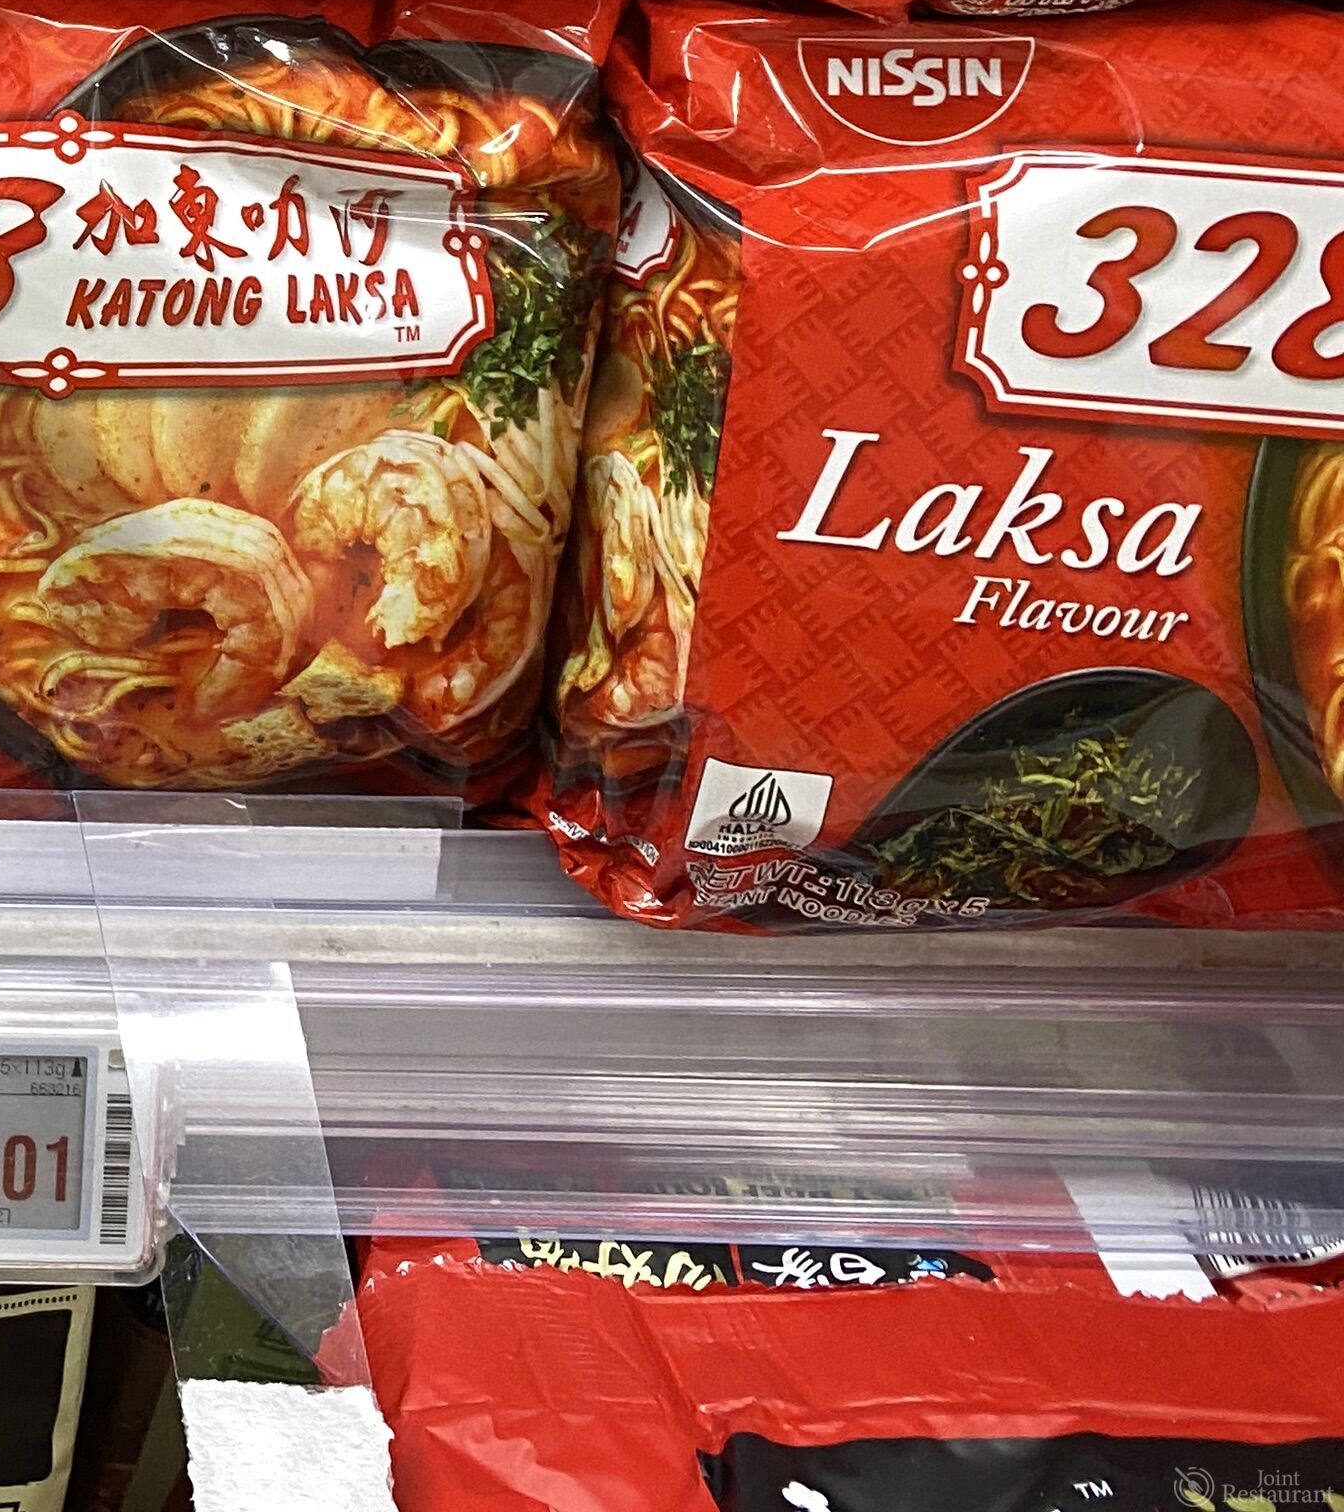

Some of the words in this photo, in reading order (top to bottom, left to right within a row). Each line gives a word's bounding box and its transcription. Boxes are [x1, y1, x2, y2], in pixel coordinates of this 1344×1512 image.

[827, 49, 1002, 107] NISSIN
[66, 275, 263, 330] KATONG
[286, 268, 420, 325] LAKSA
[394, 325, 421, 343] TM
[777, 428, 1202, 576] Laksa
[953, 575, 1189, 642] Flavour
[1072, 1479, 1114, 1500] TM
